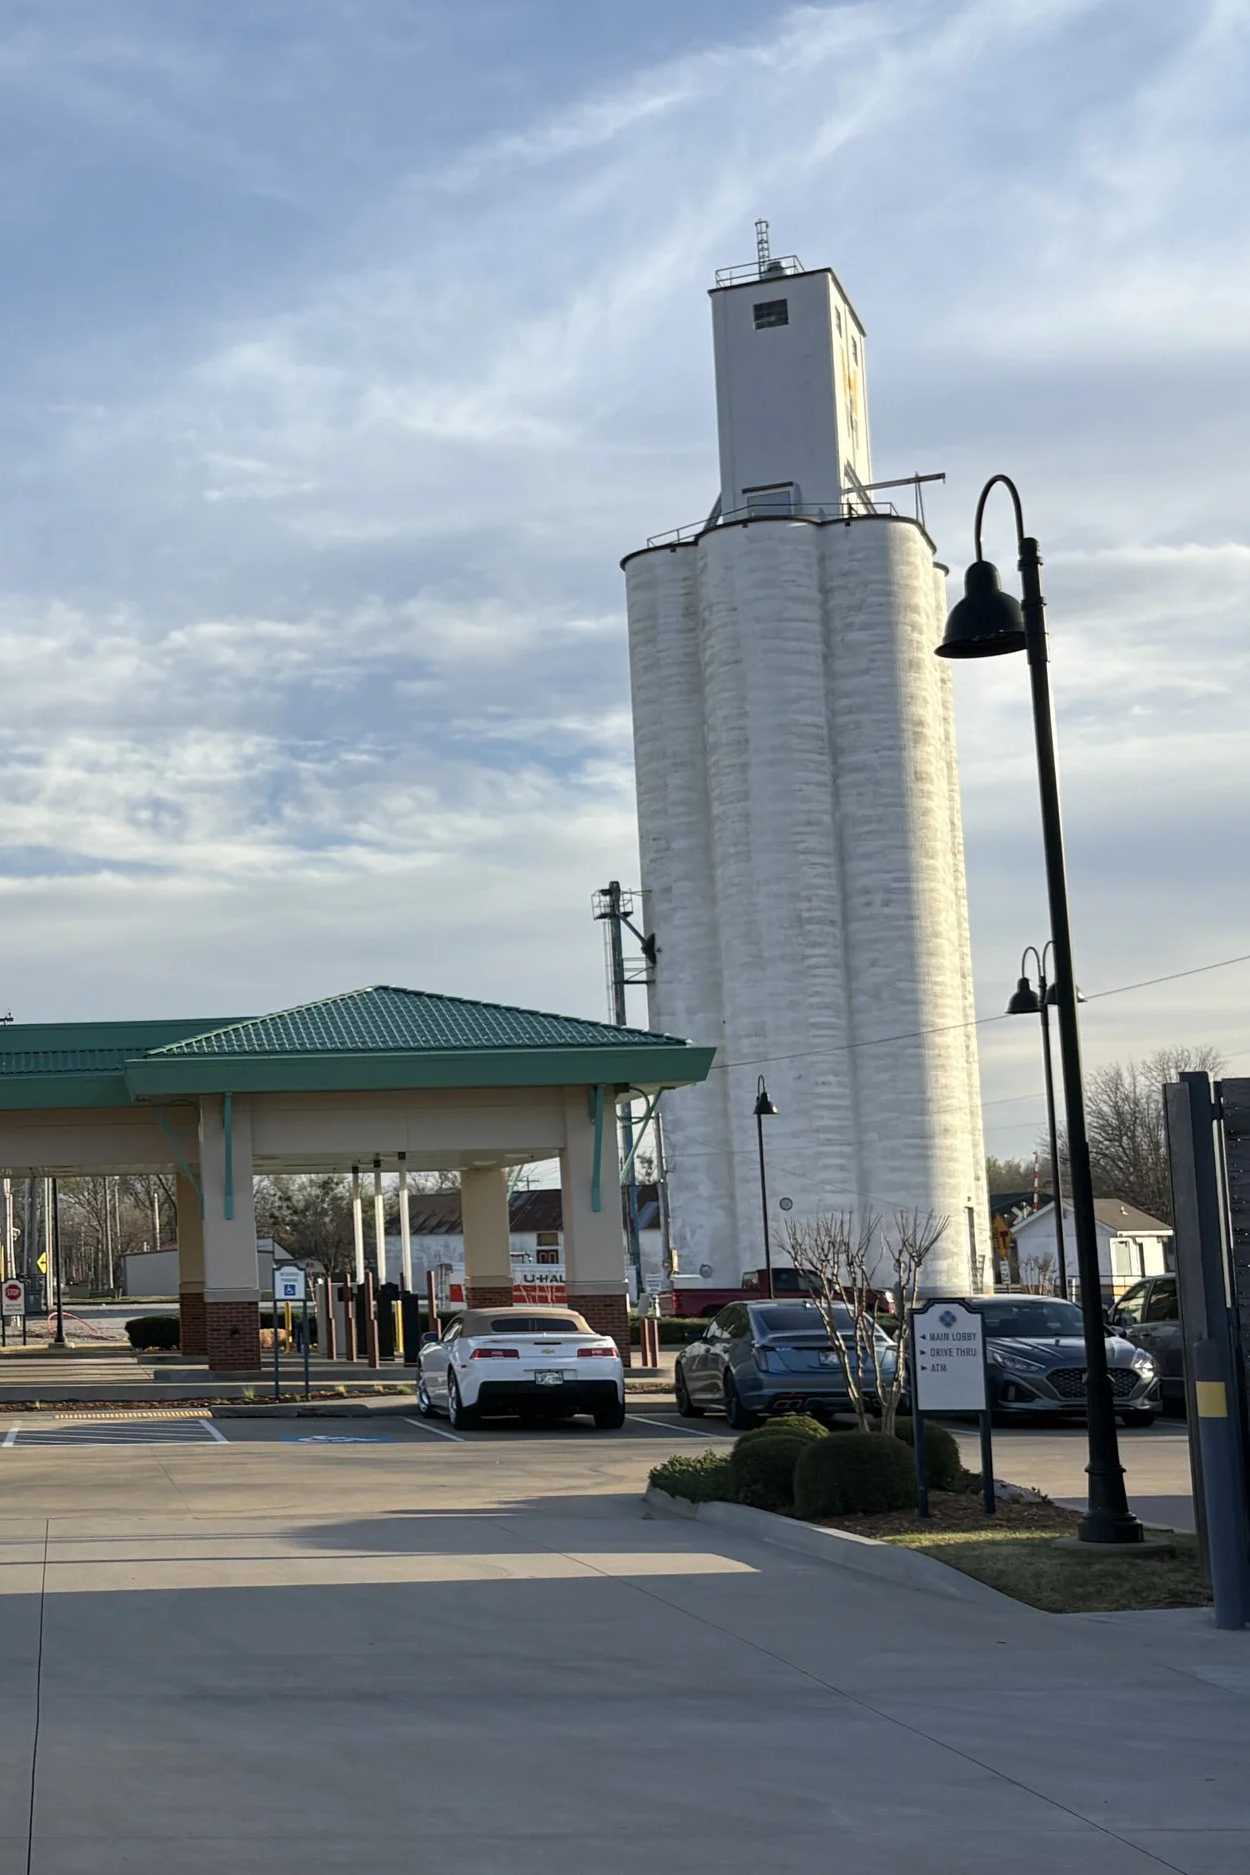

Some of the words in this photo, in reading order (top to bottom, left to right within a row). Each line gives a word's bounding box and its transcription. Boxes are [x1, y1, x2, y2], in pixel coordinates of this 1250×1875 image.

[929, 1332, 949, 1341] MAIN
[952, 1332, 977, 1341] LOBBY
[930, 1347, 954, 1357] DRIVE
[956, 1347, 977, 1357] THRU
[931, 1363, 948, 1373] ATM
